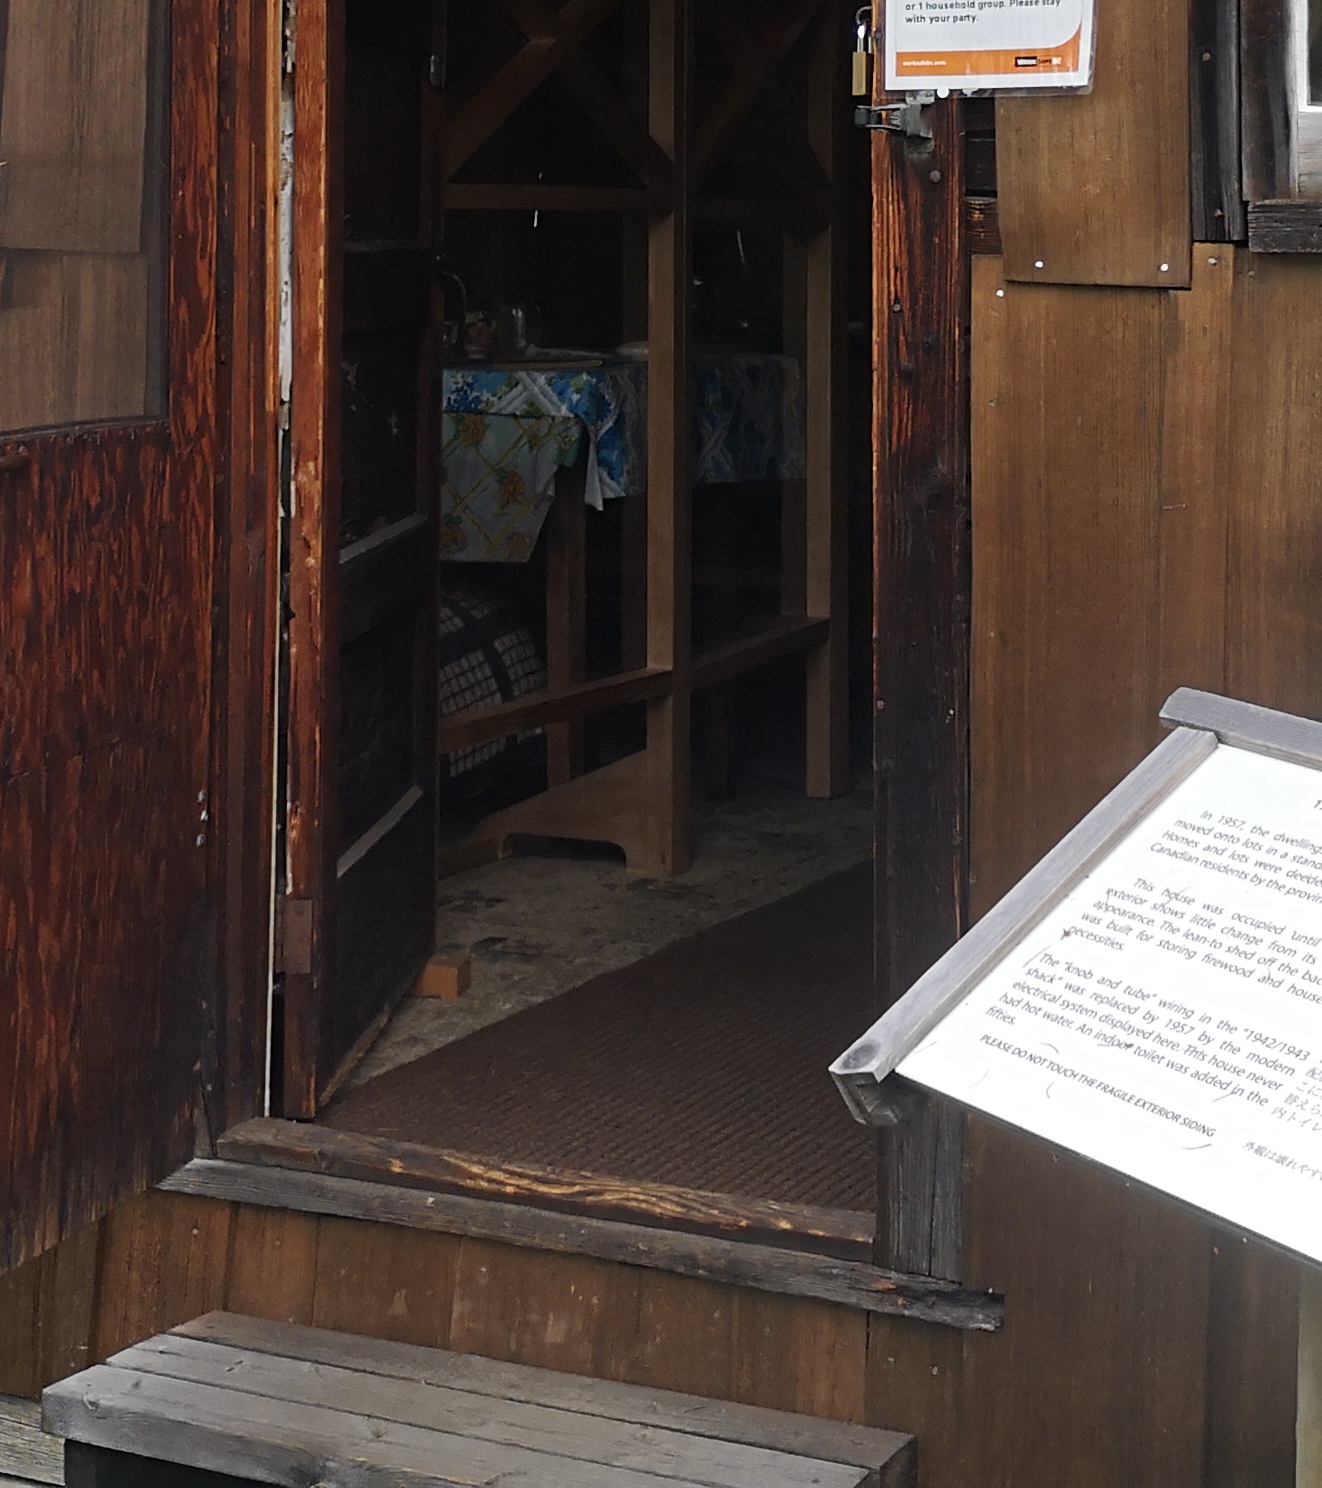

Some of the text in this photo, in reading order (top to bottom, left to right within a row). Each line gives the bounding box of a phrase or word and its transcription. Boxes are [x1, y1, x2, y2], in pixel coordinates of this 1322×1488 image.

[904, 3, 916, 11] or
[925, 0, 975, 10] household
[904, 13, 979, 24] with your party.
[1161, 829, 1200, 847] Homes
[1201, 844, 1228, 856] and
[1227, 849, 1250, 863] lots
[1253, 859, 1282, 873] were
[1173, 819, 1214, 835] moved
[1212, 831, 1240, 844] onto
[1241, 837, 1264, 851] lots
[1264, 847, 1278, 855] in
[1278, 851, 1289, 859] a
[1199, 810, 1213, 820] In
[1217, 815, 1246, 831] 1957,
[1249, 825, 1270, 837] the
[1149, 842, 1199, 864] Canadian
[1199, 859, 1249, 879] residents
[1248, 872, 1266, 886] by
[1265, 879, 1286, 891] the
[1092, 899, 1155, 926] appearance.
[1159, 919, 1180, 934] The
[1181, 928, 1223, 949] lean-to
[1224, 944, 1257, 960] shed
[1256, 956, 1279, 971] off
[1276, 962, 1299, 976] the
[1105, 887, 1148, 905] exterior
[1149, 901, 1186, 919] shows
[1189, 913, 1216, 929] little
[1219, 926, 1263, 945] change
[1267, 940, 1297, 957] from
[1300, 951, 1316, 964] its
[1133, 877, 1155, 892] This
[1160, 887, 1195, 905] house
[1201, 903, 1225, 915] was
[1230, 912, 1286, 934] occupied
[1290, 930, 1322, 946] until
[1080, 912, 1103, 925] was
[1105, 918, 1133, 935] built
[1135, 929, 1154, 942] for
[1156, 939, 1197, 960] storing
[1200, 952, 1255, 978] firewood
[1256, 972, 1285, 988] and
[985, 1005, 1016, 1025] fifties.
[1038, 952, 1060, 967] The
[1095, 976, 1122, 989] and
[1157, 998, 1195, 1019] wiring
[1197, 1012, 1212, 1024] in
[1215, 1019, 1238, 1034] the
[1063, 981, 1086, 995] was
[1089, 992, 1140, 1015] replaced
[1141, 1009, 1160, 1024] by
[1164, 1018, 1195, 1034] 1957
[1196, 1030, 1215, 1045] by
[1218, 1040, 1241, 1054] the
[1245, 1052, 1295, 1076] modern
[998, 991, 1024, 1007] had
[1020, 1000, 1043, 1015] hot
[1041, 1010, 1074, 1028] water.
[1074, 1022, 1093, 1036] An
[1132, 1045, 1165, 1064] toilet
[1165, 1059, 1190, 1074] was
[1189, 1070, 1233, 1090] added
[1227, 1083, 1245, 1096] in
[1246, 1090, 1269, 1106] the
[1012, 980, 1283, 1090] electrical system displayed here. This house never
[979, 1034, 1216, 1137] PLEASE DO NOT TOUCH THE FRAGILE EXTERIOR SIDING
